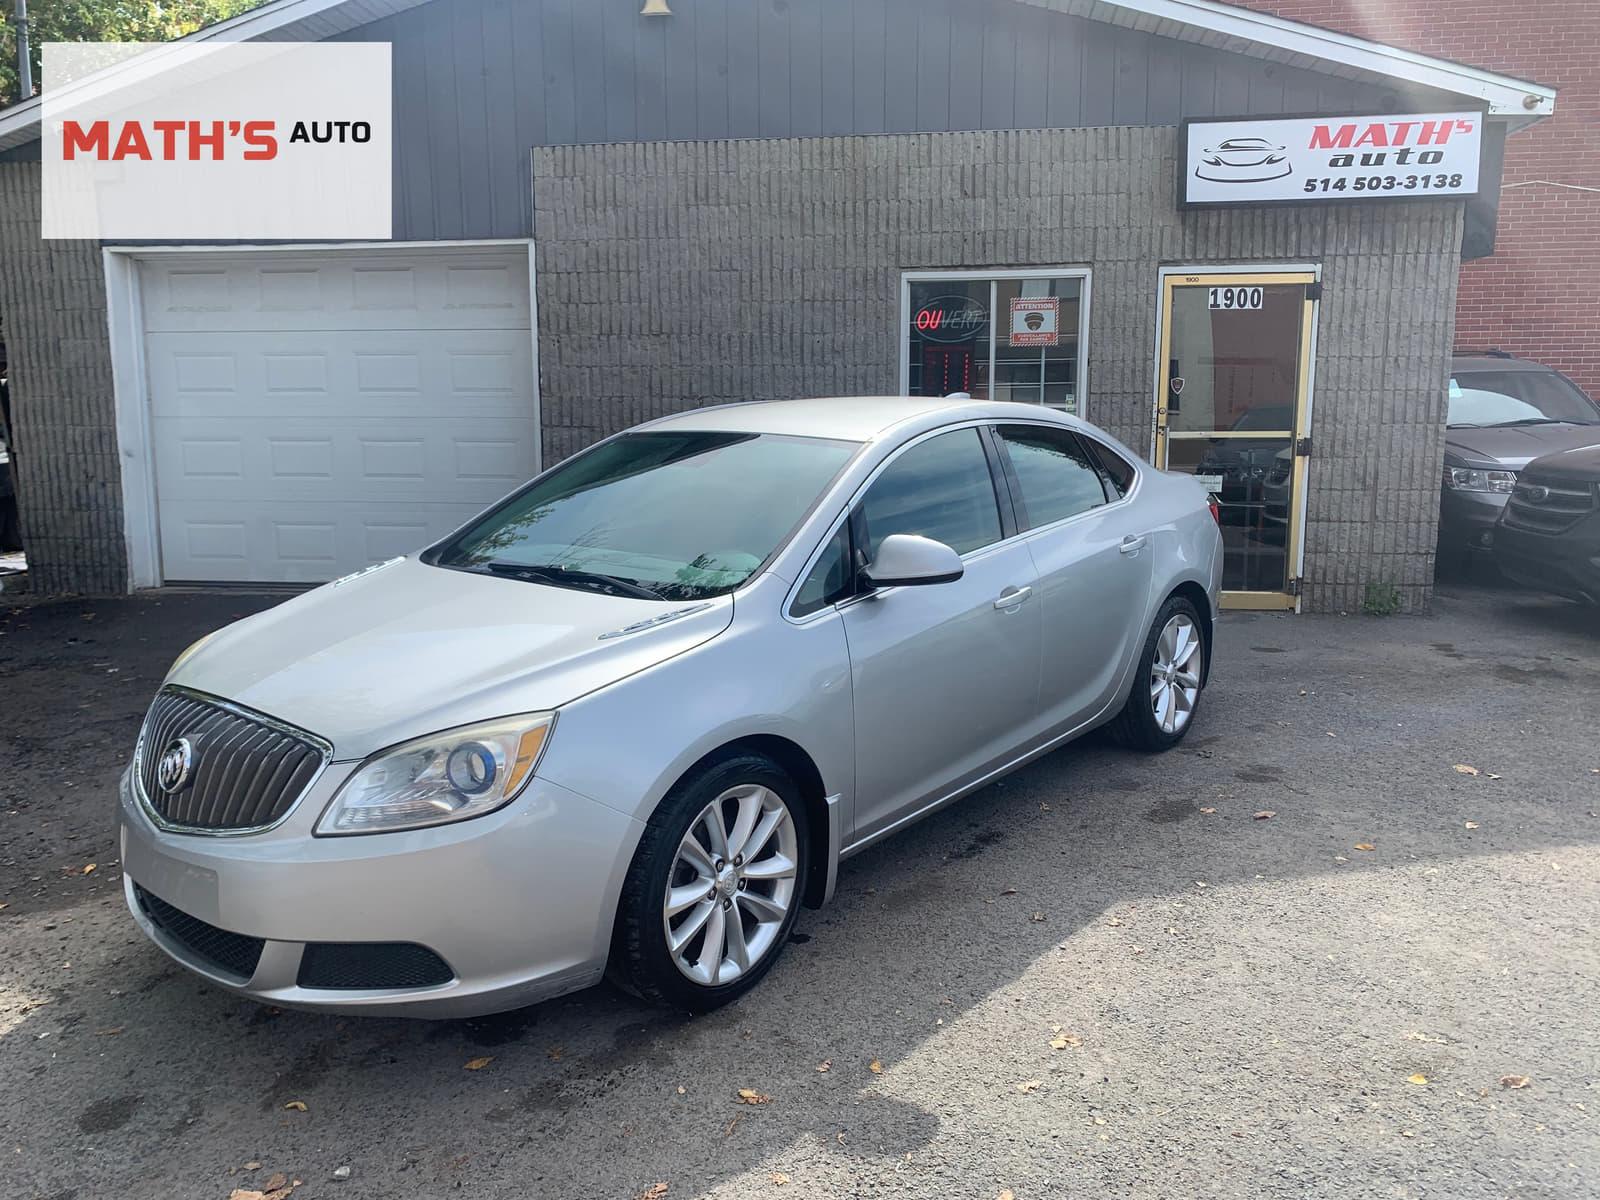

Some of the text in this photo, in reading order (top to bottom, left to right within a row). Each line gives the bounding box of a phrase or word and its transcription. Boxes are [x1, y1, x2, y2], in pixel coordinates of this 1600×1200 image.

[1328, 147, 1443, 168] auto
[1303, 173, 1463, 193] 514 503-3138
[1209, 288, 1262, 309] 1900
[917, 309, 981, 330] OUVERT
